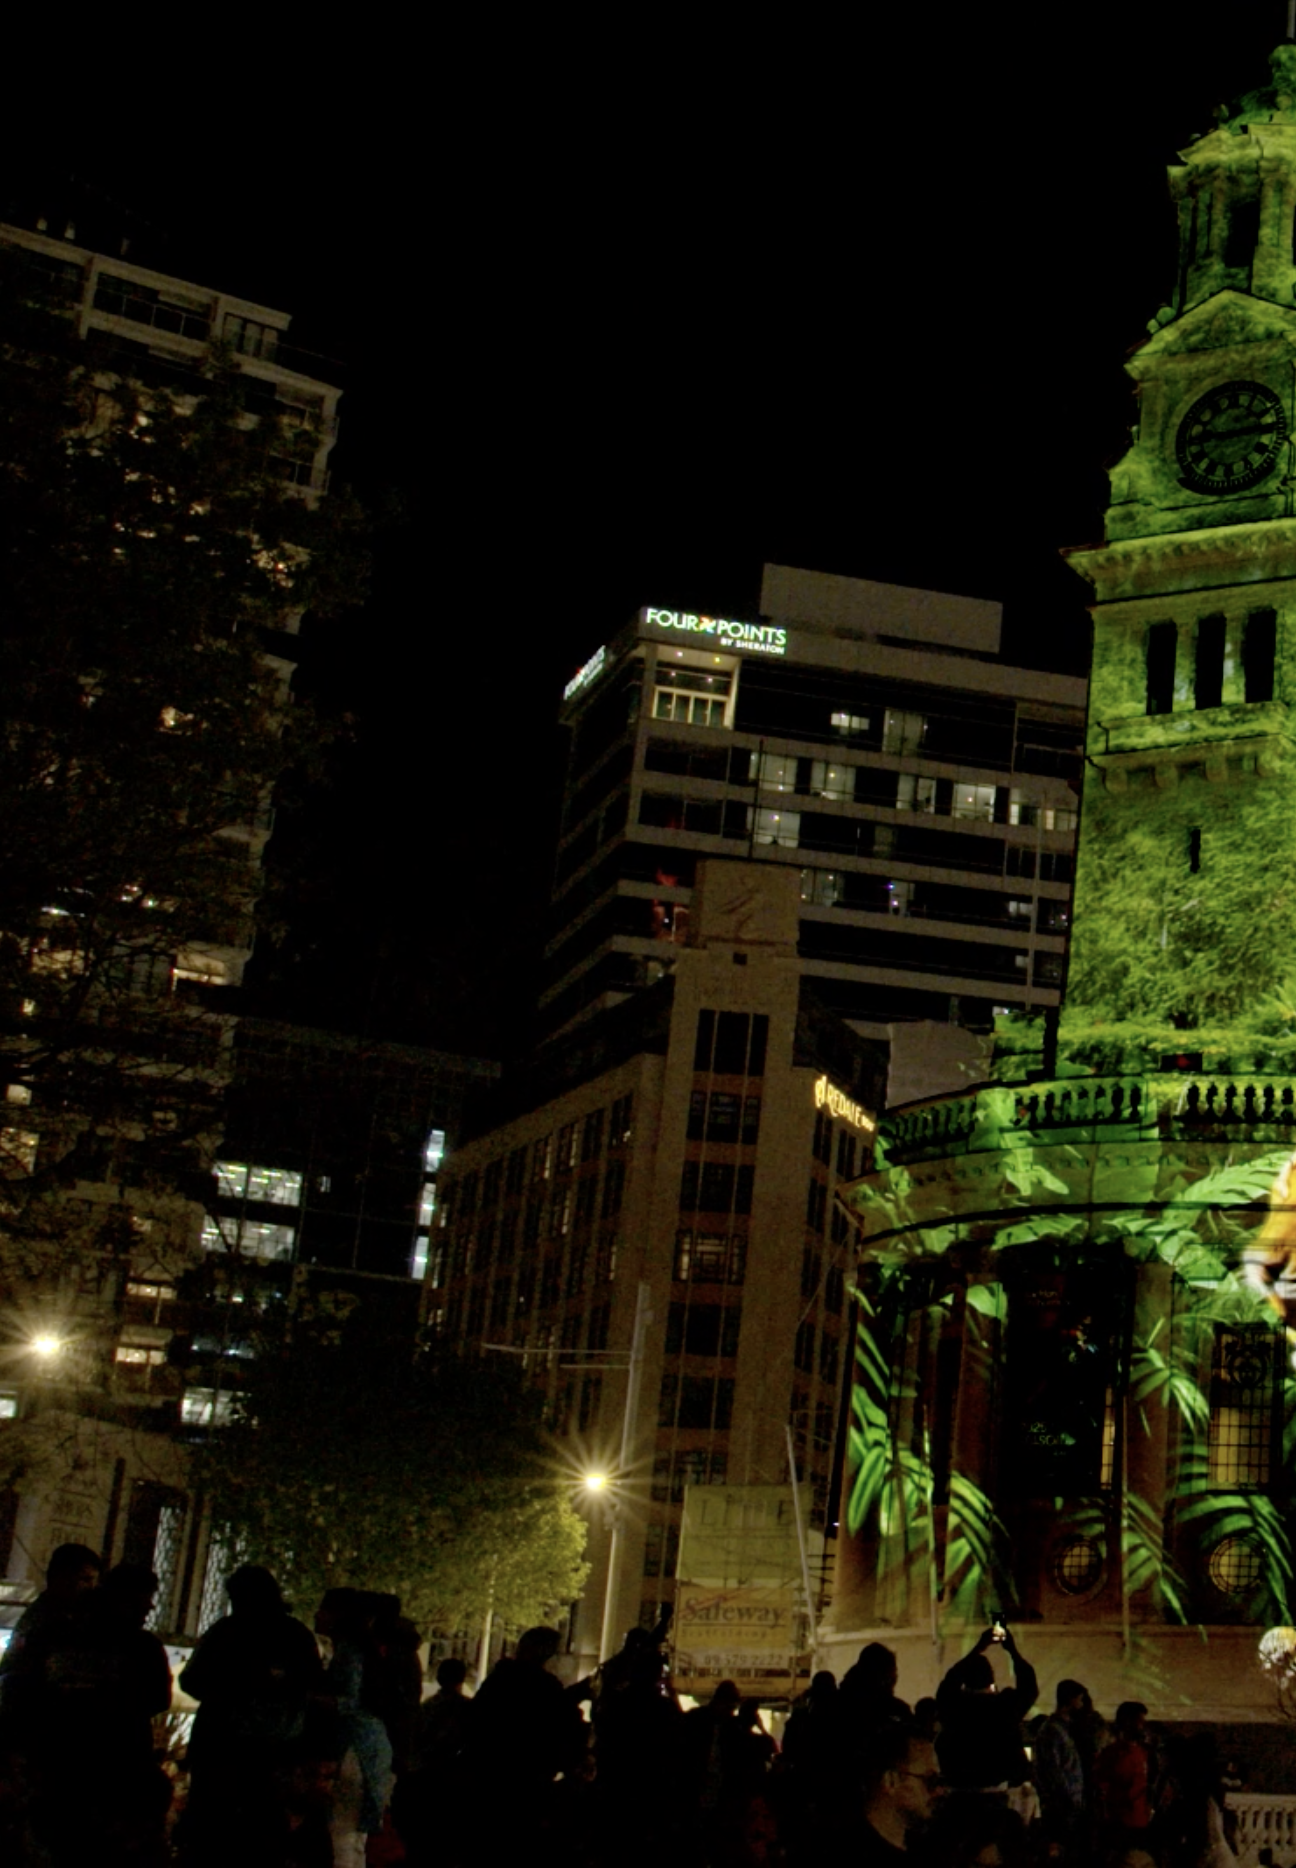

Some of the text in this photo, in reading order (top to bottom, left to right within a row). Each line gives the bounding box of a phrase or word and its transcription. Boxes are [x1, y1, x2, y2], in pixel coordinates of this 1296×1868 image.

[646, 608, 787, 646] FOUR POINTS
[720, 637, 785, 655] BY SHERATON
[683, 1598, 787, 1630] Safeway
[750, 1652, 783, 1666] 2222
